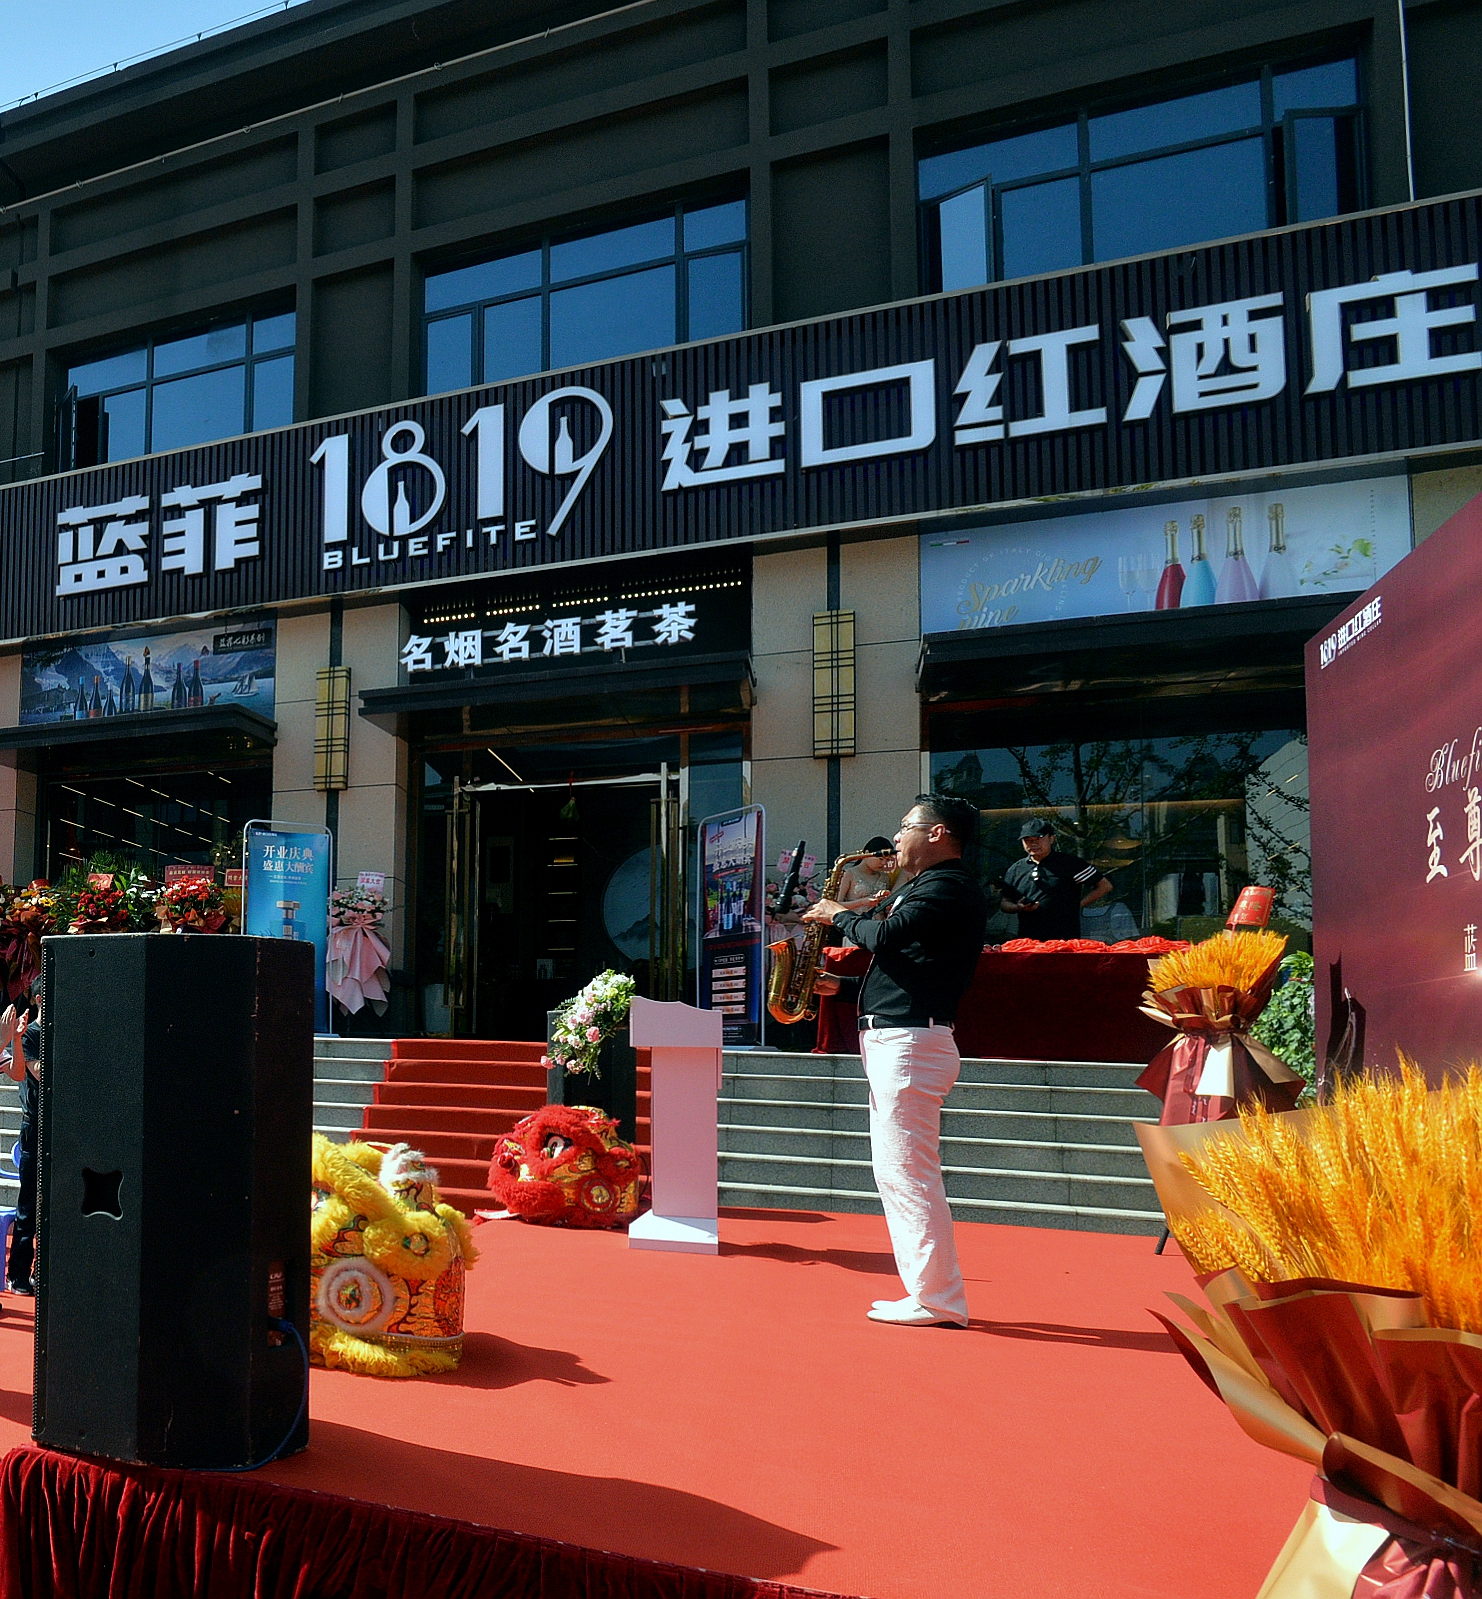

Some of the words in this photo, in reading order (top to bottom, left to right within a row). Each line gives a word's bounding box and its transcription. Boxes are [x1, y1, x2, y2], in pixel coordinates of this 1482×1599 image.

[55, 473, 263, 597] 蓝菲
[309, 385, 613, 545] 1819
[660, 262, 1482, 491] 进口红酒庄
[322, 519, 538, 570] BLUEFITE
[956, 555, 1103, 616] Sparkling
[399, 601, 696, 672] 名烟名酒茗茶
[263, 845, 315, 861] 开业庆典
